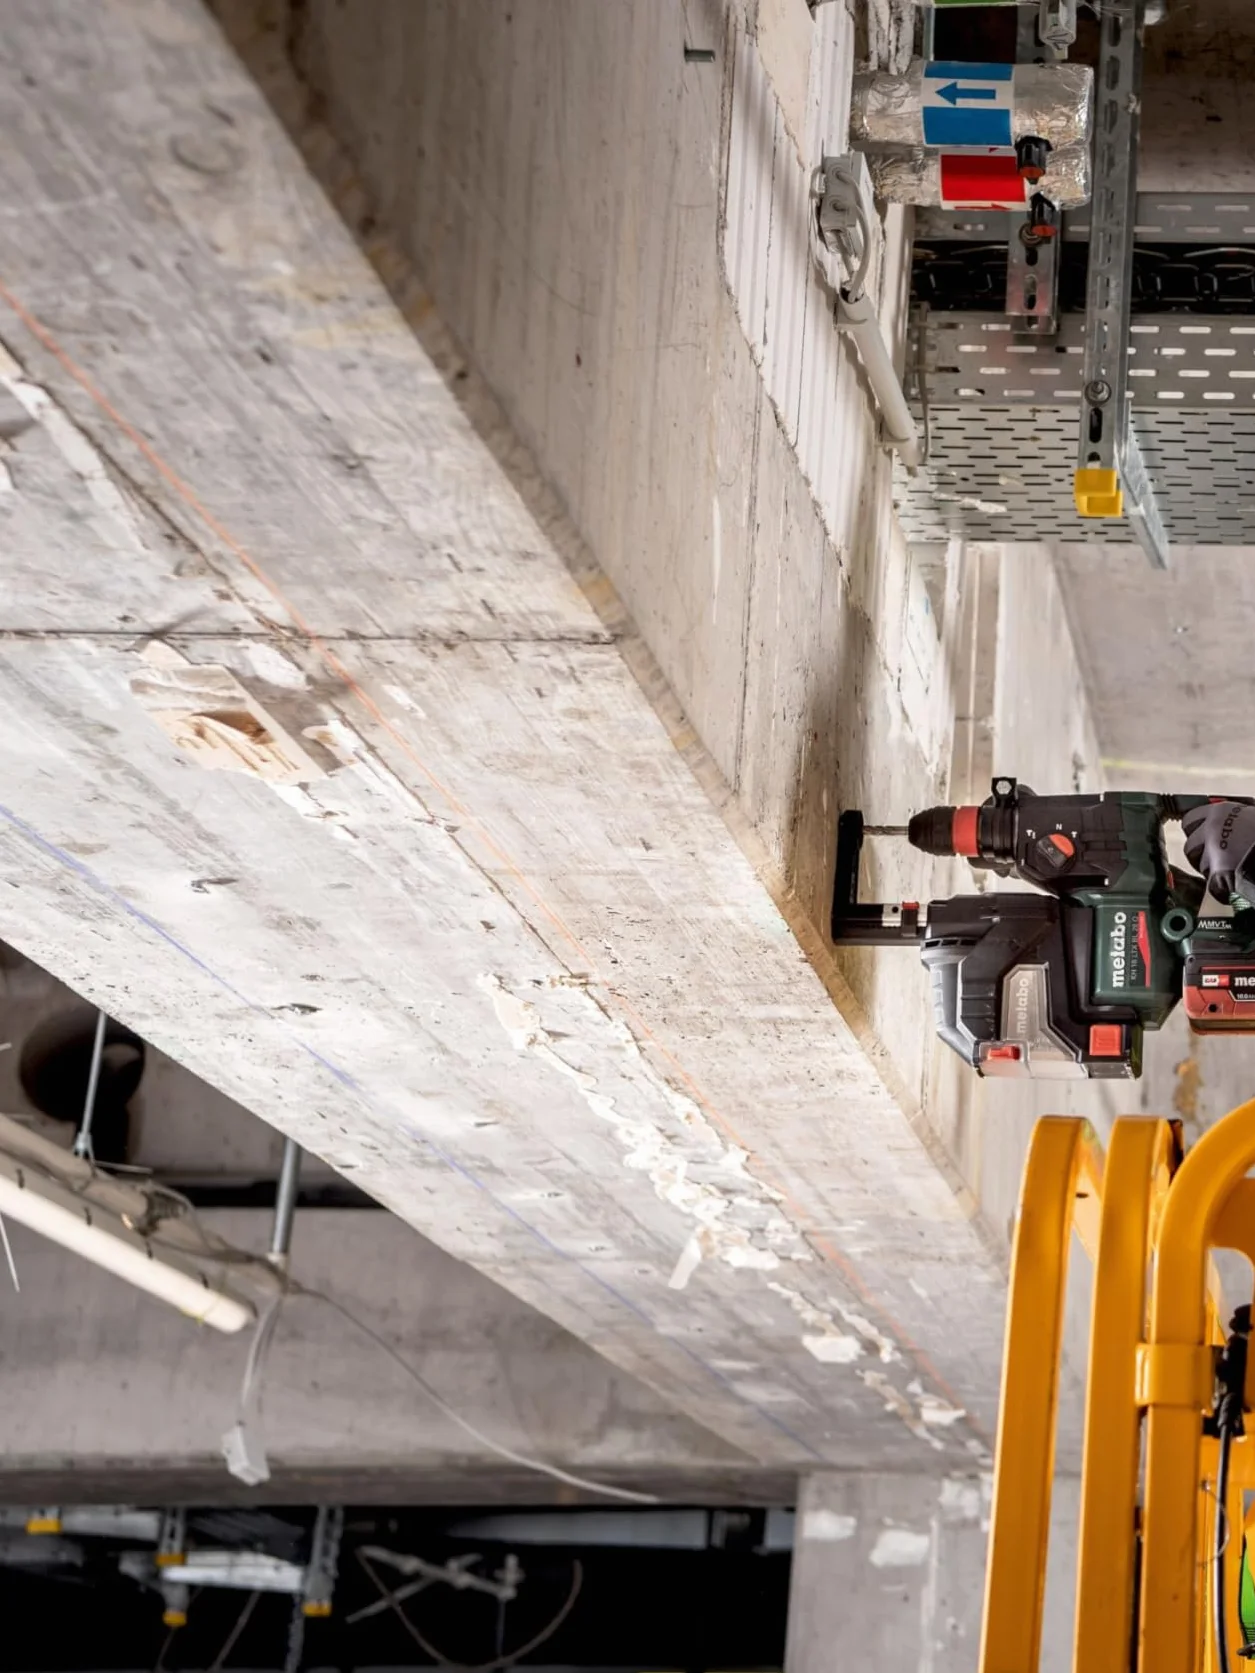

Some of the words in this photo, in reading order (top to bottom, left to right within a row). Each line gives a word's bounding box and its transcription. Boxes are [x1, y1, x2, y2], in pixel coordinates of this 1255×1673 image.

[1220, 806, 1241, 850] etabo
[1110, 911, 1127, 988] metabo
[1015, 978, 1029, 1034] metabo
